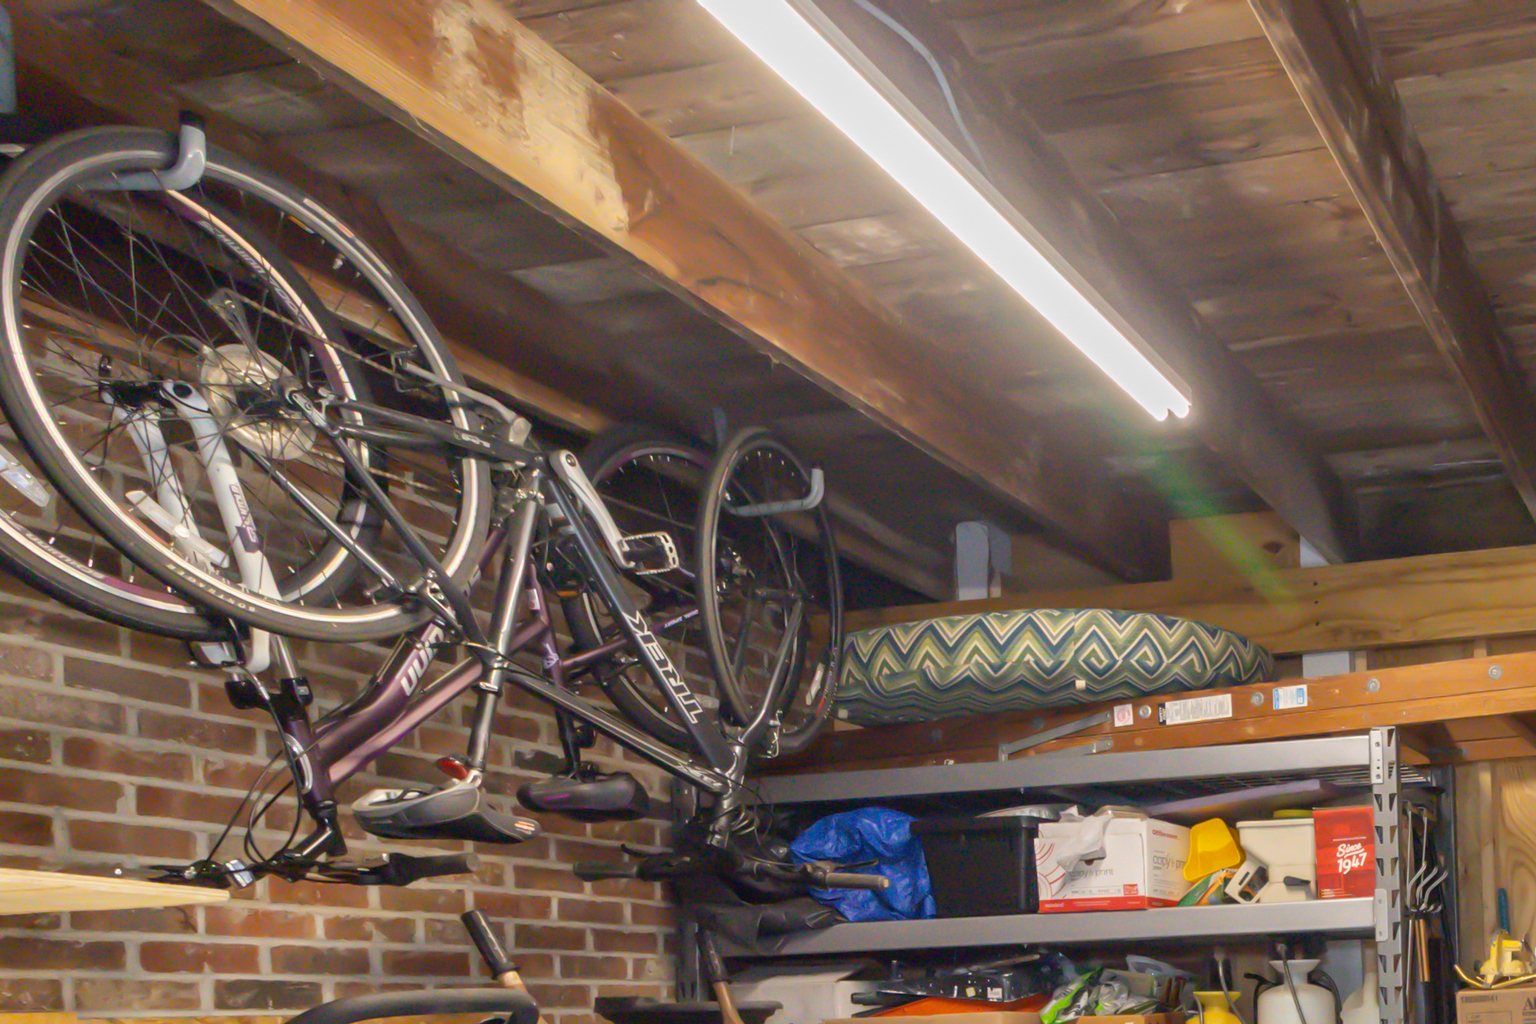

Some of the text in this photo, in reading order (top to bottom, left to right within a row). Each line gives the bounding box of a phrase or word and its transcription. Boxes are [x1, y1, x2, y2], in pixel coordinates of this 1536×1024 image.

[622, 610, 703, 724] TREK
[1336, 842, 1364, 857] Since
[1094, 868, 1114, 878] print
[1337, 852, 1368, 875] 1947
